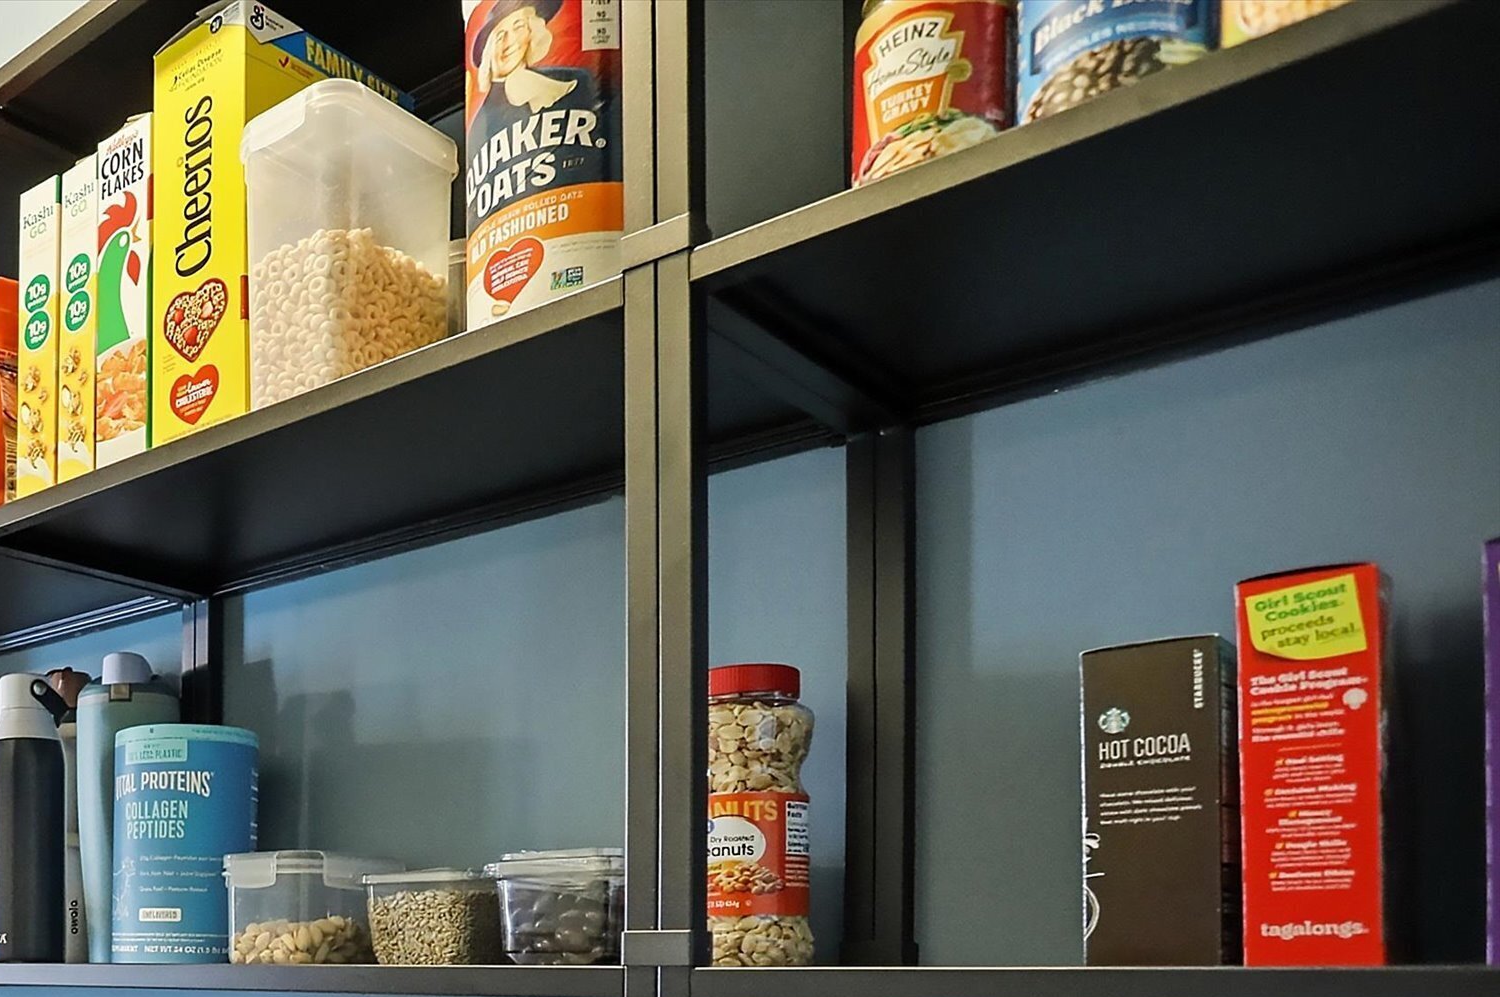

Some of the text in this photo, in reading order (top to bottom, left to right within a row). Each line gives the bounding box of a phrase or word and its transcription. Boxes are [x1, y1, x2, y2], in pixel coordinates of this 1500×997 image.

[879, 21, 939, 58] HEINZ
[305, 35, 363, 82] FAMILY
[881, 81, 934, 113] TURKEY
[882, 96, 930, 124] GRAVY
[101, 138, 143, 180] CORN
[466, 109, 598, 206] QUAKER
[101, 161, 145, 200] FLAKES
[175, 95, 213, 278] Cheerios
[476, 151, 557, 218] OATS
[64, 181, 95, 209] Kashi
[70, 198, 88, 218] GO
[22, 204, 54, 230] Kashi
[29, 221, 47, 239] GO
[489, 202, 570, 249] FASHIONED
[69, 260, 88, 280] 10g
[28, 282, 47, 302] 10g
[69, 300, 88, 319] 10g
[28, 319, 47, 339] 10g
[1255, 583, 1347, 612] Girl Scout
[1264, 599, 1340, 622] Cookies
[1261, 615, 1334, 641] proceeds
[1277, 633, 1310, 648] stay
[1193, 650, 1204, 709] STARBUCKS
[1249, 683, 1298, 696] Cookie
[1250, 666, 1348, 687] The Girl Scout
[1099, 732, 1191, 761] HOT COCOA
[1100, 755, 1190, 769] DOUBLE CHOCOLATE
[141, 770, 211, 798] PROTEINS
[125, 800, 188, 820] COLLAGEN
[127, 819, 185, 840] PEPTIDES
[710, 836, 722, 844] Dry
[68, 900, 78, 935] owala
[143, 945, 159, 954] NET
[160, 945, 173, 954] WT
